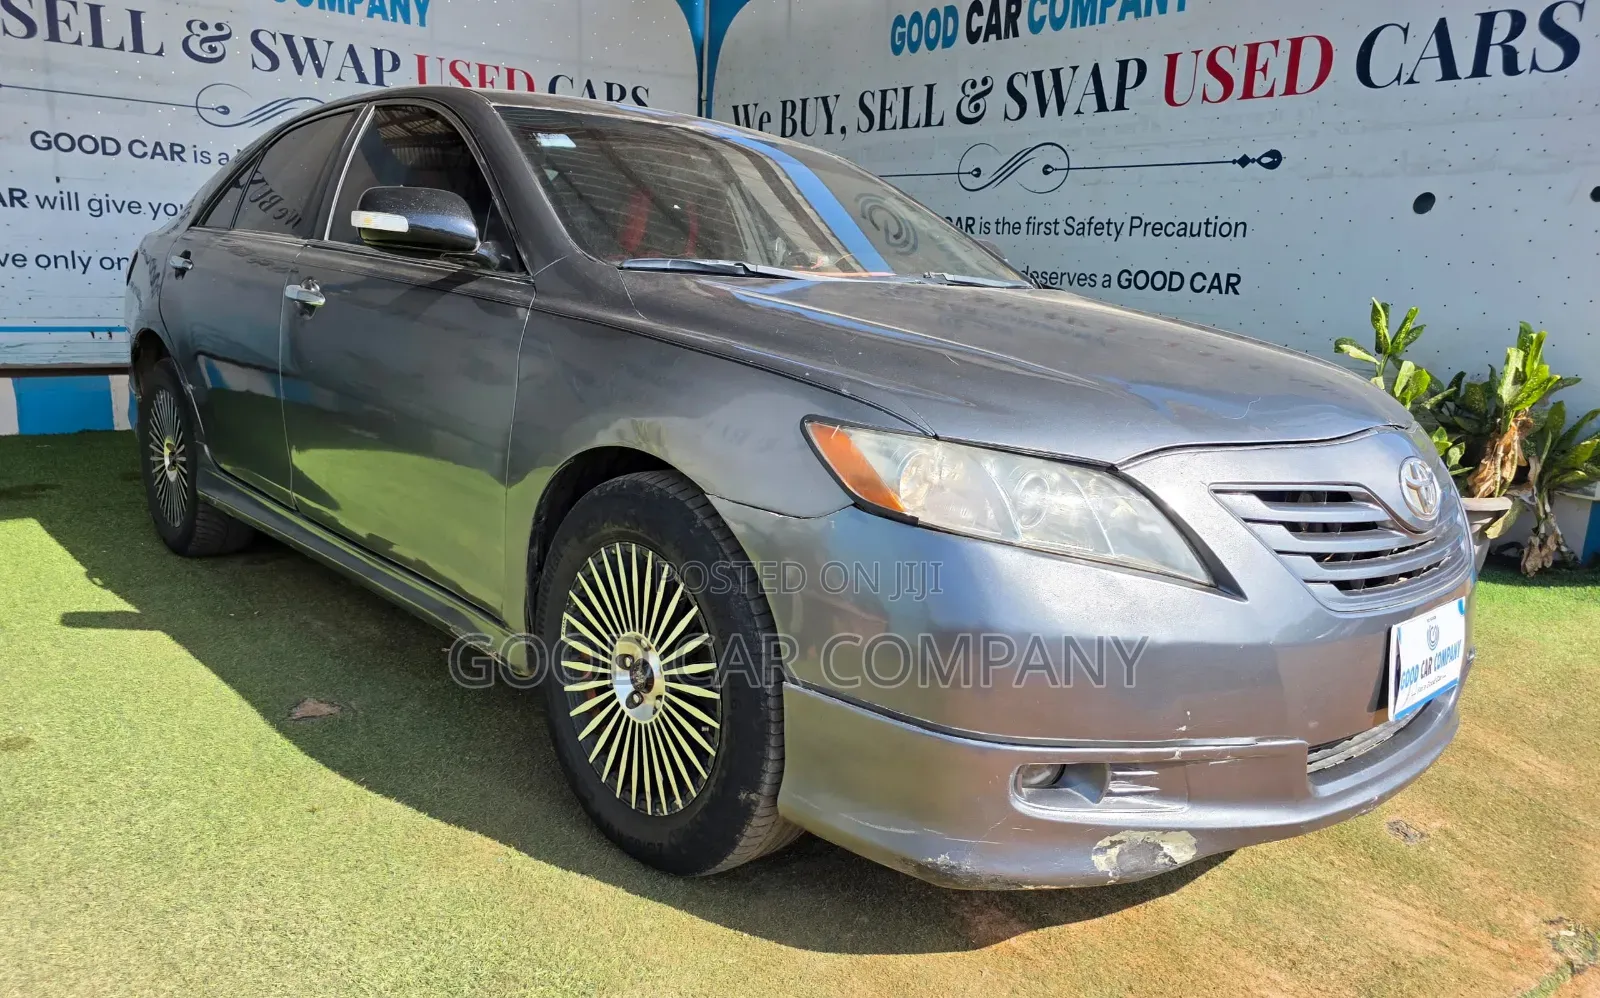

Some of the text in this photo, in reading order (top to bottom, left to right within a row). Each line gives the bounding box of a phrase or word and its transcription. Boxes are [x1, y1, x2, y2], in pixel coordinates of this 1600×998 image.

[1, 0, 165, 57] SELL
[182, 19, 232, 63] &
[250, 28, 401, 87] SWAP
[413, 53, 535, 92] USED
[890, 5, 959, 56] GOOD
[966, 0, 1021, 44] CAR
[732, 0, 1587, 141] We BUY, SELL & SWAP USED CARS
[30, 130, 230, 166] GOOD CAR is a
[35, 190, 80, 211] will
[87, 193, 142, 217] give
[148, 201, 184, 220] yo
[979, 216, 992, 235] is
[995, 216, 1022, 235] the
[1025, 216, 1060, 236] first
[1064, 216, 1125, 242] Safety
[1129, 216, 1248, 238] Precaution
[35, 250, 92, 274] only
[1101, 273, 1113, 289] a
[1117, 269, 1185, 293] GOOD
[1189, 272, 1242, 295] CAR
[1400, 664, 1420, 691] GOOD
[1420, 656, 1433, 680] CAR
[1433, 639, 1462, 672] COMPANY
